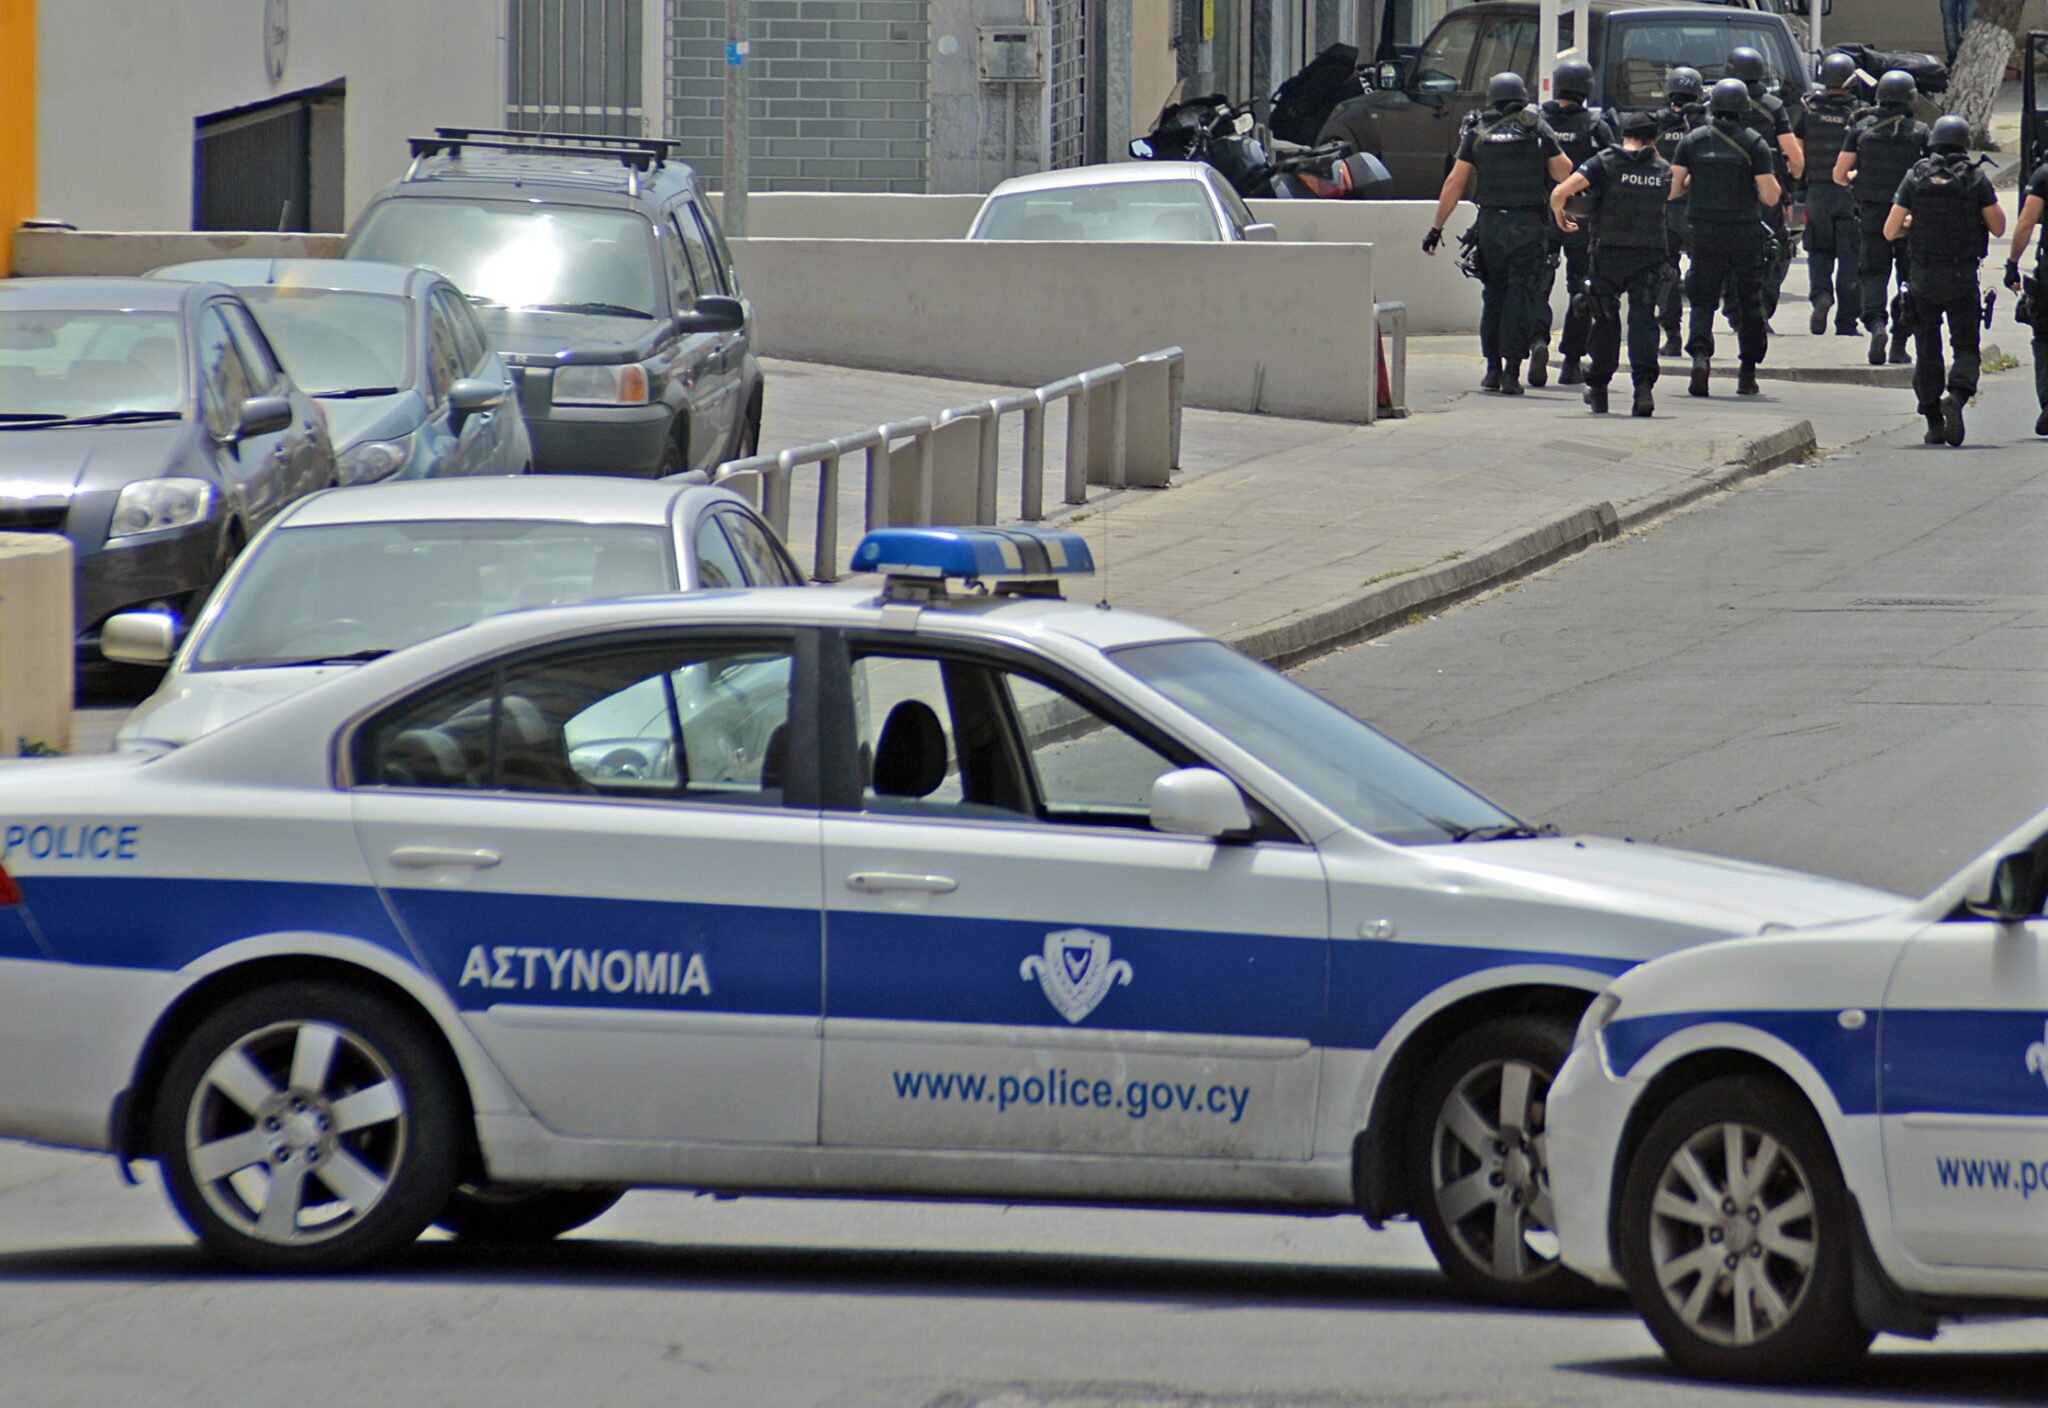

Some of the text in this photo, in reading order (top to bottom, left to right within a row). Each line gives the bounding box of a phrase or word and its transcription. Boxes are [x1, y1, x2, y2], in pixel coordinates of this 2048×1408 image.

[1621, 172, 1663, 187] POLICE
[5, 825, 140, 859] POLICE
[458, 944, 713, 996] ΑΣΤΥΝΟΜΙΑ
[893, 1069, 1250, 1124] www.police.gov.cy
